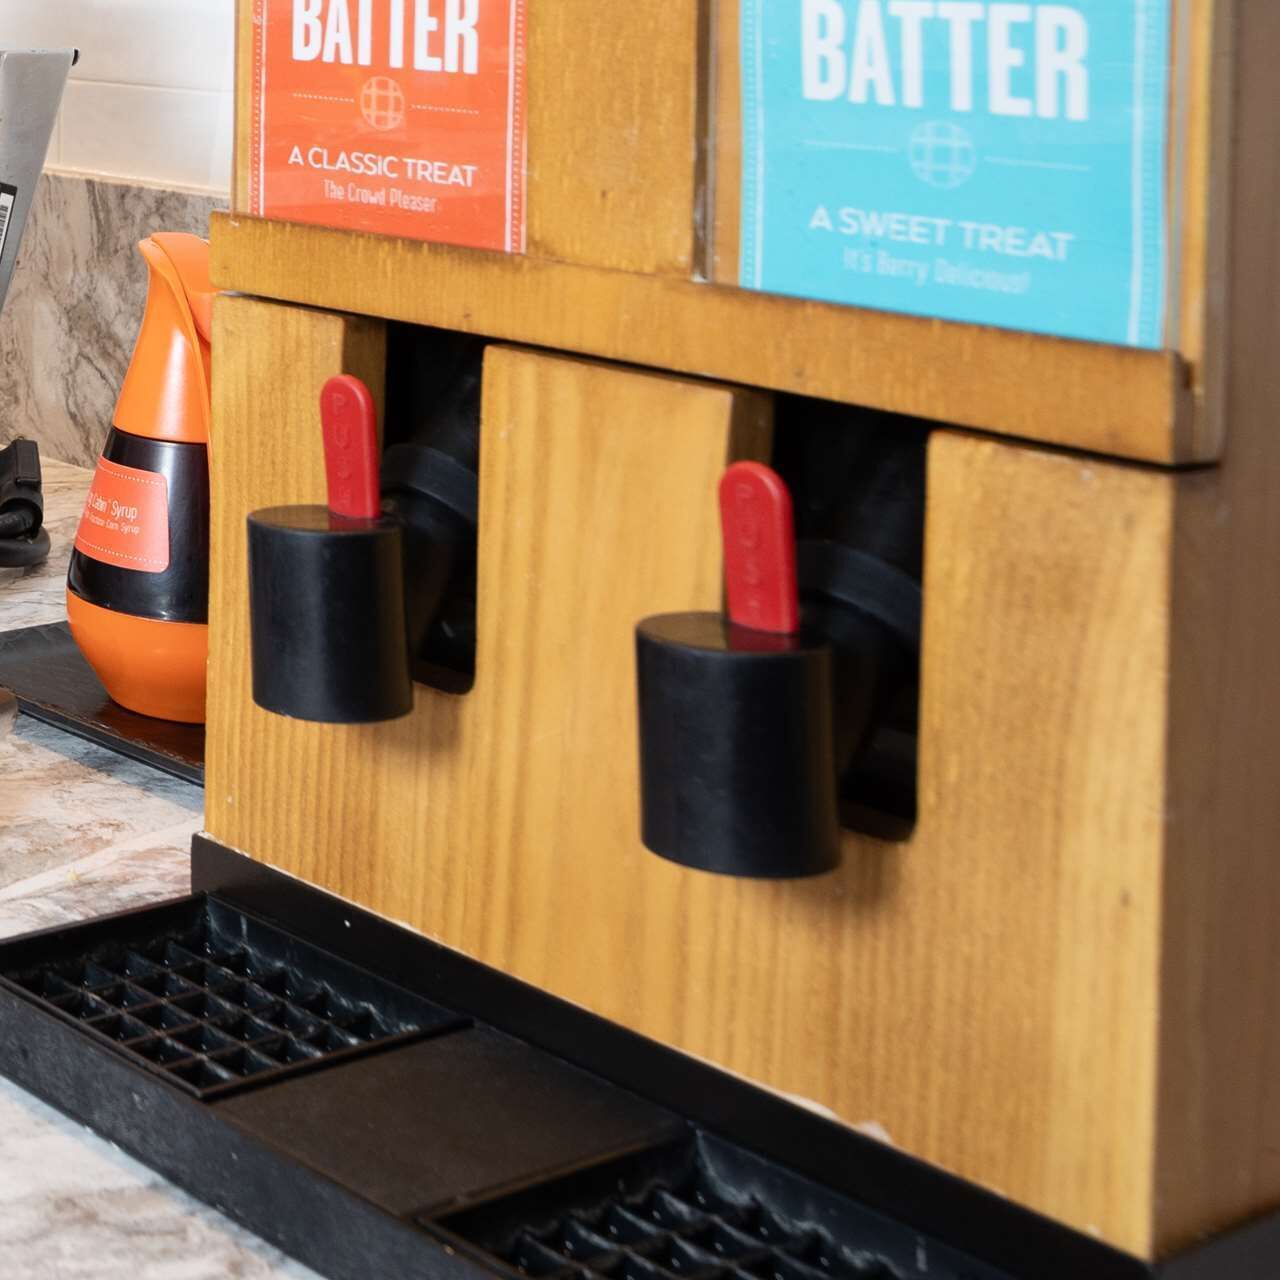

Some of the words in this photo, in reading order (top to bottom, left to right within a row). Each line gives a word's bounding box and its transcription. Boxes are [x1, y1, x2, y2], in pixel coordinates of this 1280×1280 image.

[288, 145, 304, 166] A
[307, 147, 399, 179] CLASSIC
[403, 157, 477, 188] TREAT
[324, 179, 345, 200] The
[347, 183, 385, 206] Crowd
[809, 206, 832, 231] A
[839, 208, 952, 246] SWEET
[958, 221, 1074, 261] TREAT
[111, 499, 139, 522] Syrup
